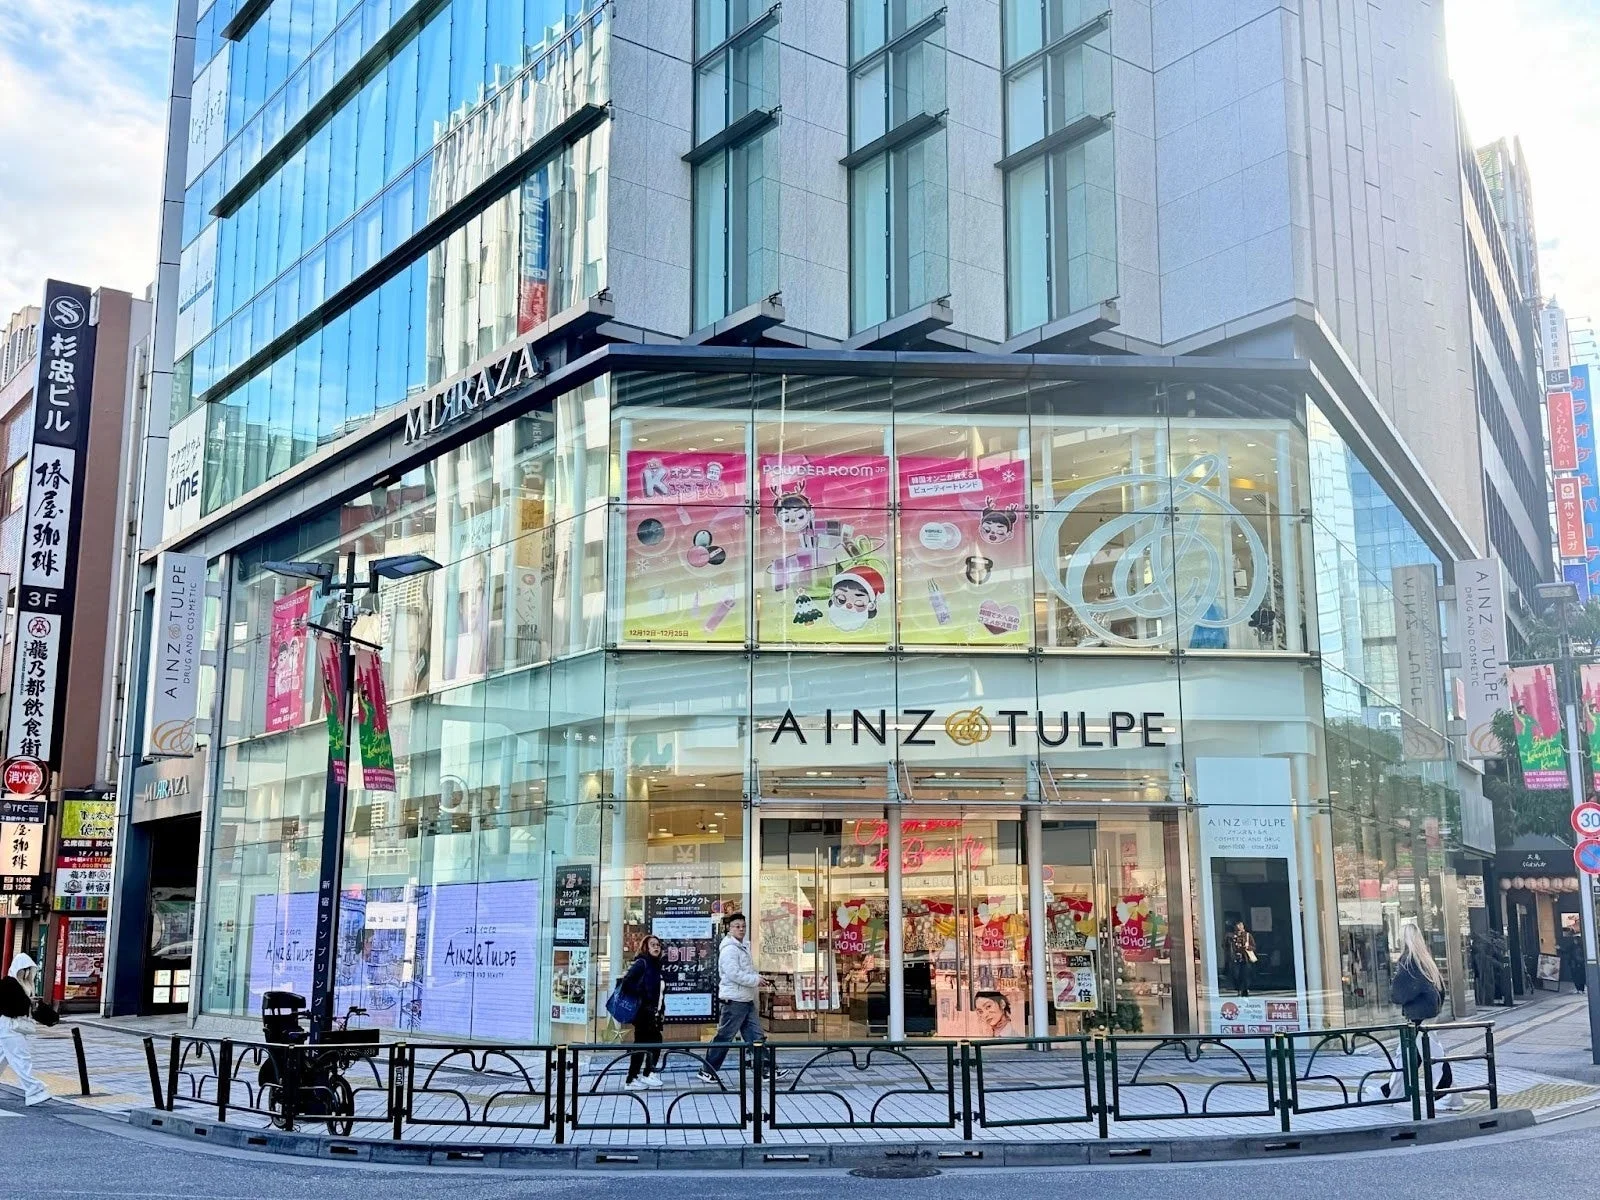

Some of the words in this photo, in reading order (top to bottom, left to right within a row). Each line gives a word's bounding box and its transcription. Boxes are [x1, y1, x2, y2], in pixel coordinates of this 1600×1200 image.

[44, 332, 78, 432] 杉忠ビル
[1550, 371, 1565, 382] 8F
[1555, 402, 1570, 453] くらわんか
[762, 464, 825, 477] POWDER
[828, 466, 873, 477] ROOM
[168, 470, 199, 511] LIME
[913, 481, 979, 494] ビューティートレンド
[31, 459, 71, 577] 椿屋珈琲
[1563, 501, 1578, 551] ホットヨガ
[28, 592, 57, 608] 3F
[169, 565, 186, 621] TULPE
[1465, 586, 1474, 612] DRUG
[1476, 571, 1493, 624] AINZ
[187, 582, 197, 631] COSMETIC
[1467, 616, 1475, 635] AND
[186, 634, 194, 655] AND
[165, 642, 182, 699] AINZ
[183, 657, 193, 684] DRUG
[1468, 638, 1479, 687] COSMETIC
[1481, 645, 1499, 702] TULPE
[20, 639, 49, 758] 龍乃都飲食街
[771, 708, 936, 745] AINZ
[998, 710, 1166, 747] TULPE
[8, 770, 40, 785] 消火栓
[101, 792, 116, 801] 4F
[12, 804, 28, 813] TFC
[1207, 818, 1240, 827] AINZ
[1252, 818, 1287, 827] TULPE
[1581, 812, 1600, 828] 30
[655, 897, 710, 905] カラーコンタクト
[843, 931, 857, 940] HO
[985, 928, 999, 938] HO
[1124, 926, 1138, 937] HO
[835, 941, 849, 950] HO
[850, 942, 867, 952] HO!
[1116, 936, 1130, 946] HO
[1131, 937, 1149, 948] HO!
[667, 946, 697, 962] B1F
[802, 976, 828, 988] TAX
[1078, 988, 1092, 1003] 倍
[1271, 1011, 1293, 1019] FREE
[1272, 1003, 1291, 1011] TAX
